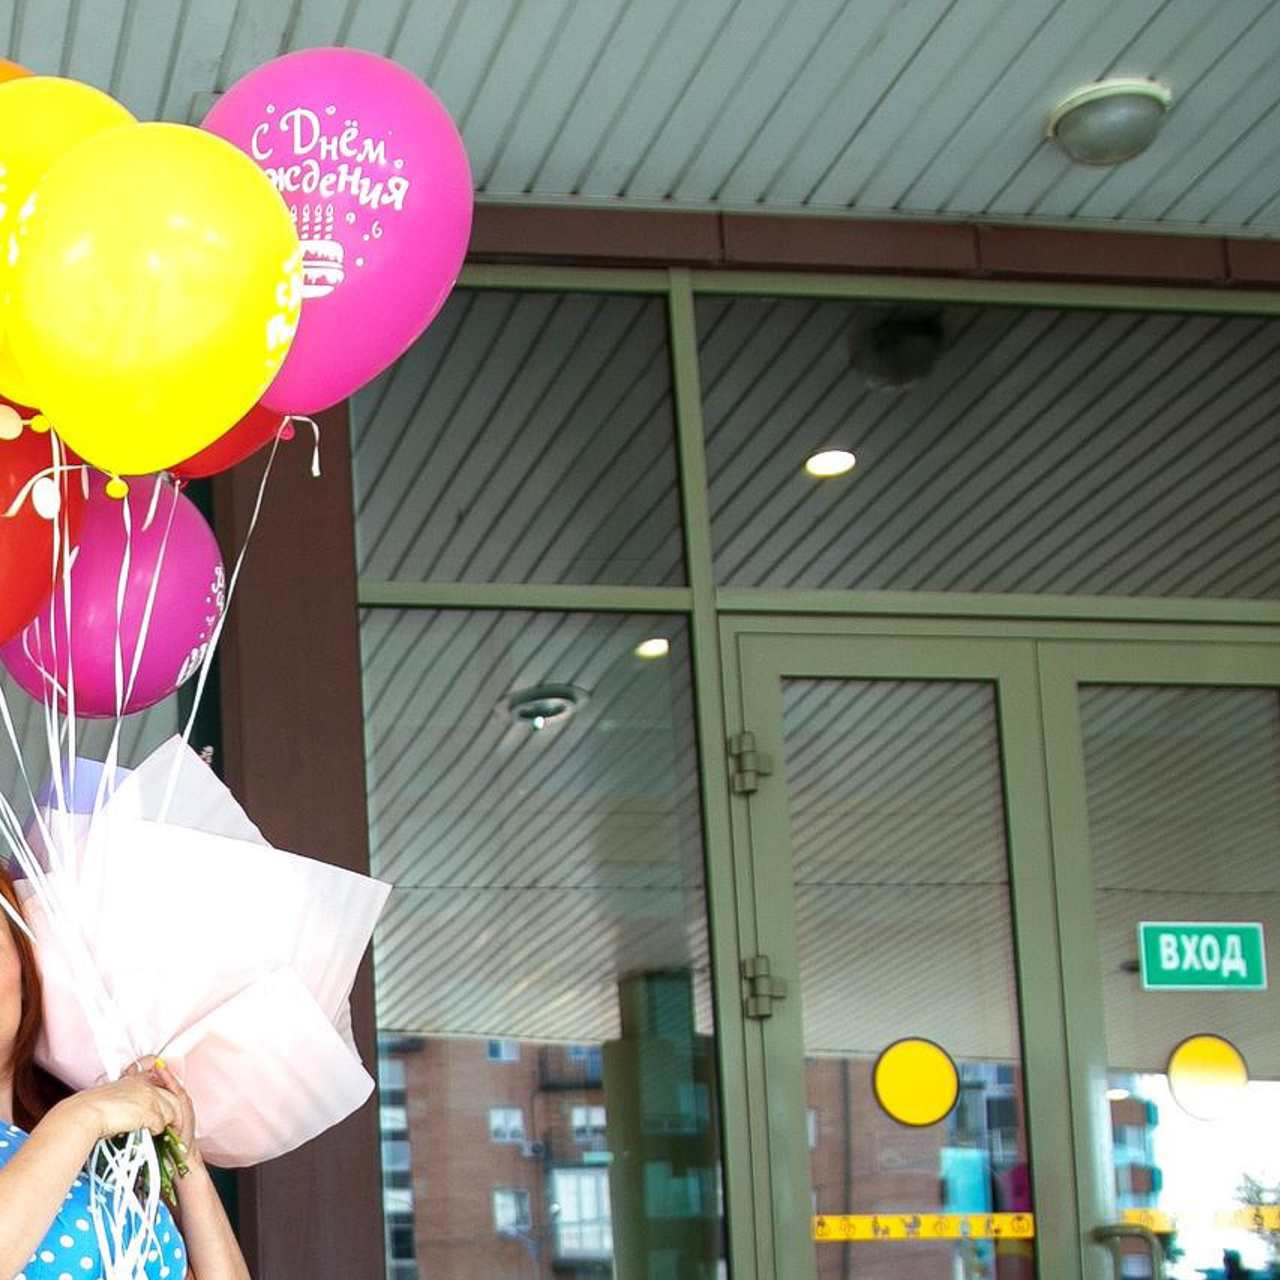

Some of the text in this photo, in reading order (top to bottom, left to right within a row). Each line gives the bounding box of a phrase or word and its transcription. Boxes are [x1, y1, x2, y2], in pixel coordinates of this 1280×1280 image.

[279, 107, 386, 166] Днём
[264, 159, 410, 211] ждения
[1159, 933, 1248, 978] ВХОД
